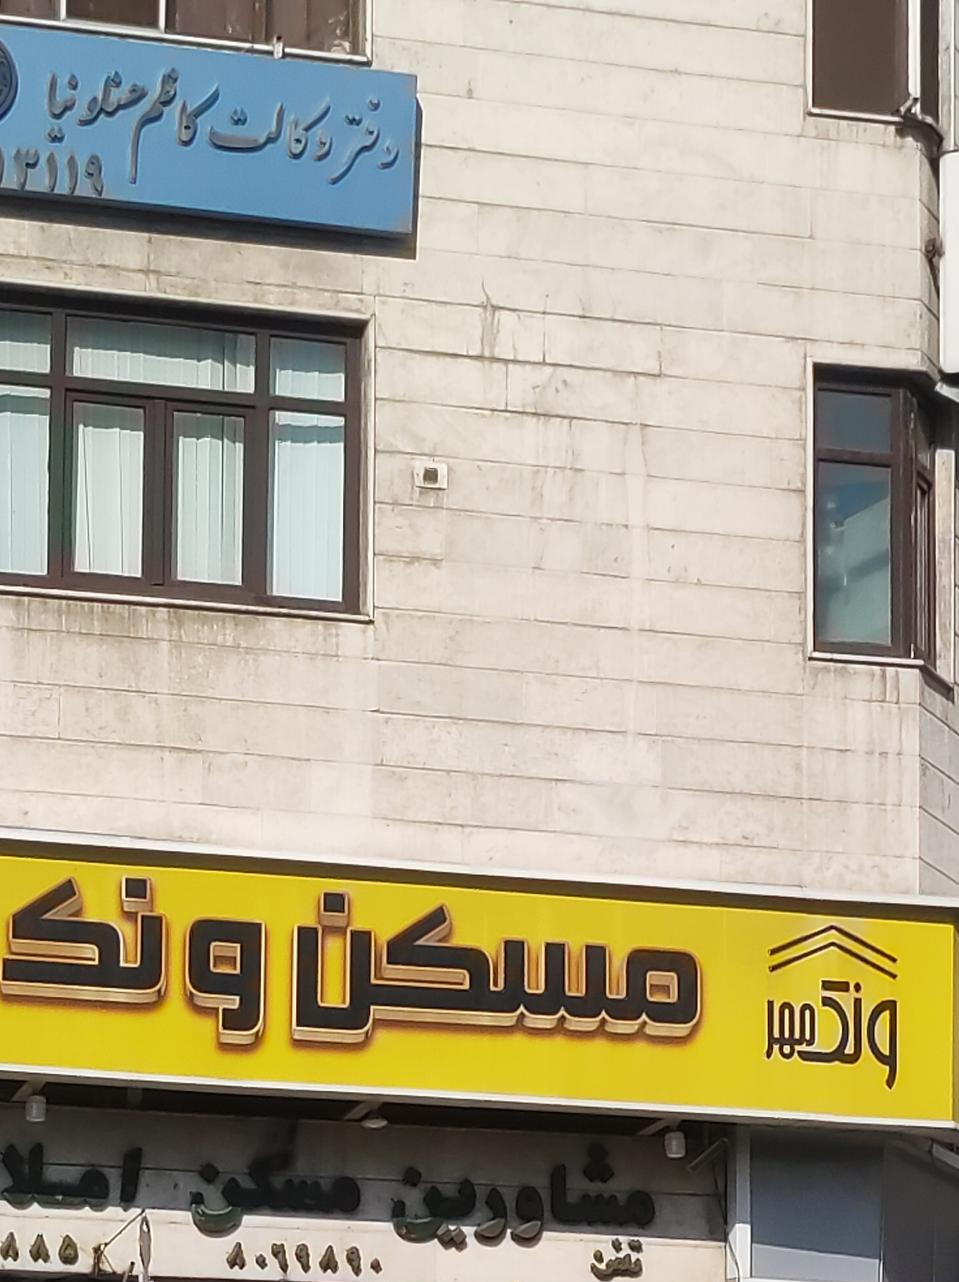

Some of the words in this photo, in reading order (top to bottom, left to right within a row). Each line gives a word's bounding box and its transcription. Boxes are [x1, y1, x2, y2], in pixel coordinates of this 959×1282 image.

[129, 67, 219, 184] کاظم
[208, 99, 331, 160] وکالت
[329, 99, 399, 184] دفتر
[291, 890, 704, 1044] مسکن
